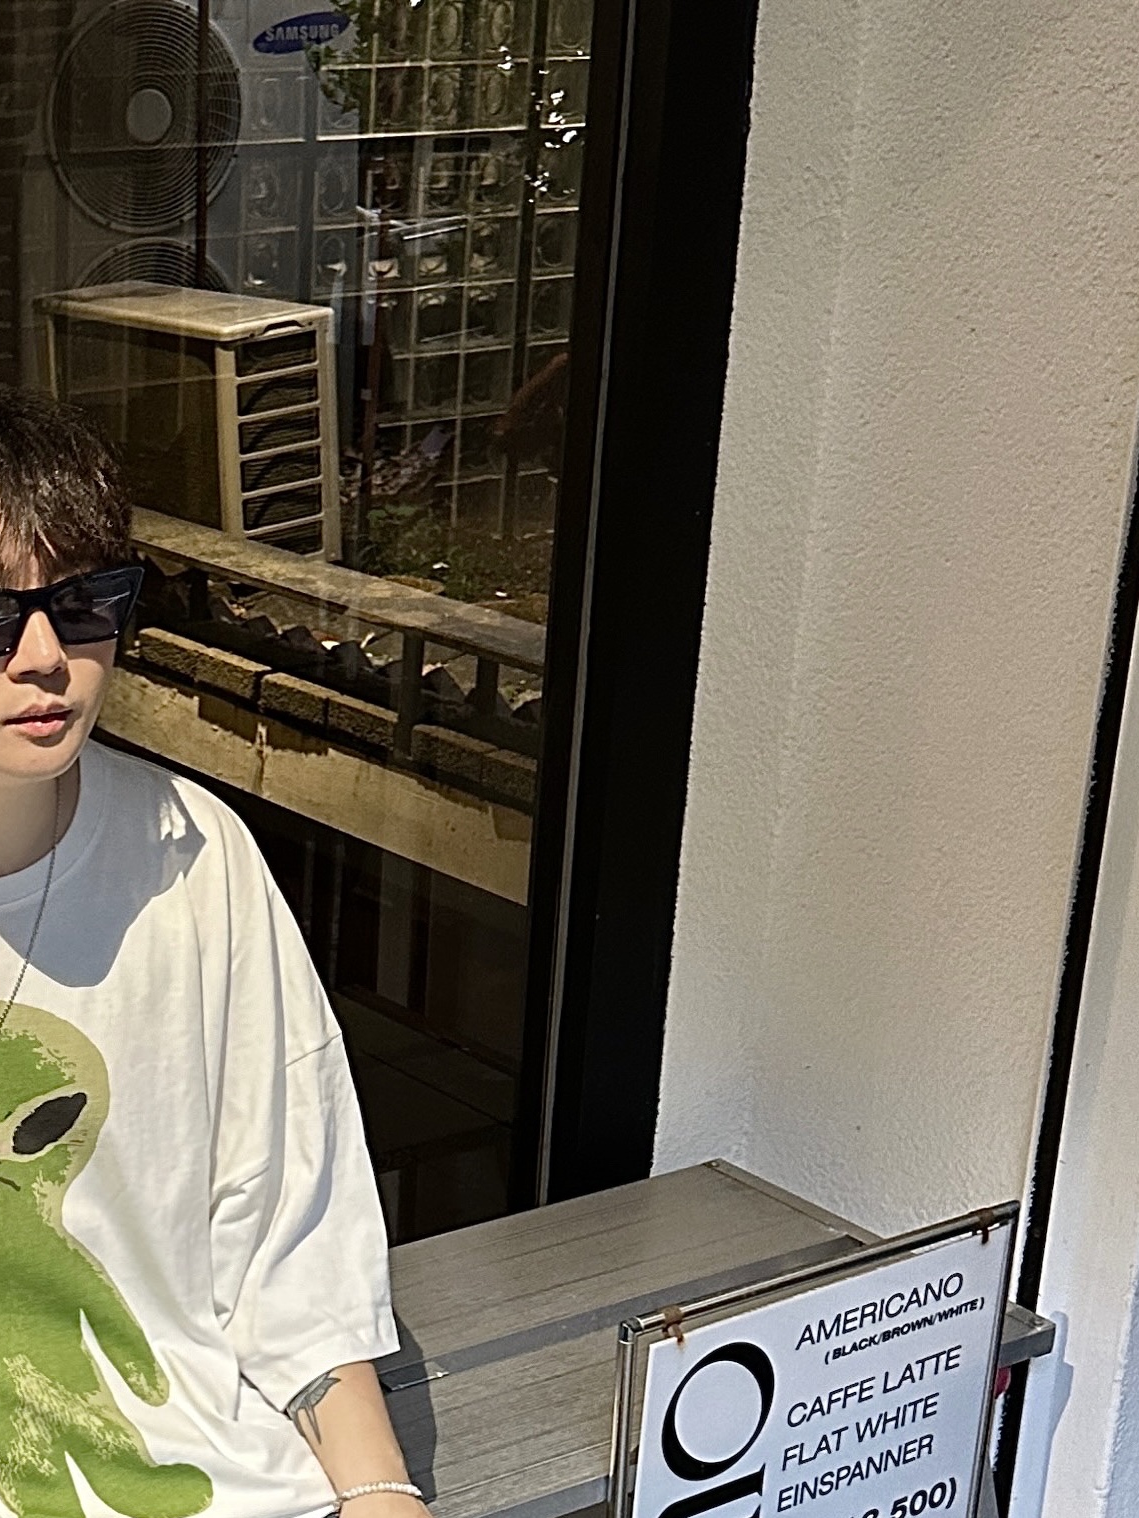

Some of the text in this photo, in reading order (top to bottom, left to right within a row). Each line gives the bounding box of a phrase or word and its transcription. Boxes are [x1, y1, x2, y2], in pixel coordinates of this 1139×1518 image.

[265, 23, 340, 42] SAMSUNG
[795, 1272, 964, 1351] AMERICANO
[786, 1345, 962, 1428] CAFFE LATTE
[781, 1392, 940, 1471] FLAT WHITE
[777, 1434, 934, 1513] EINSPANNER
